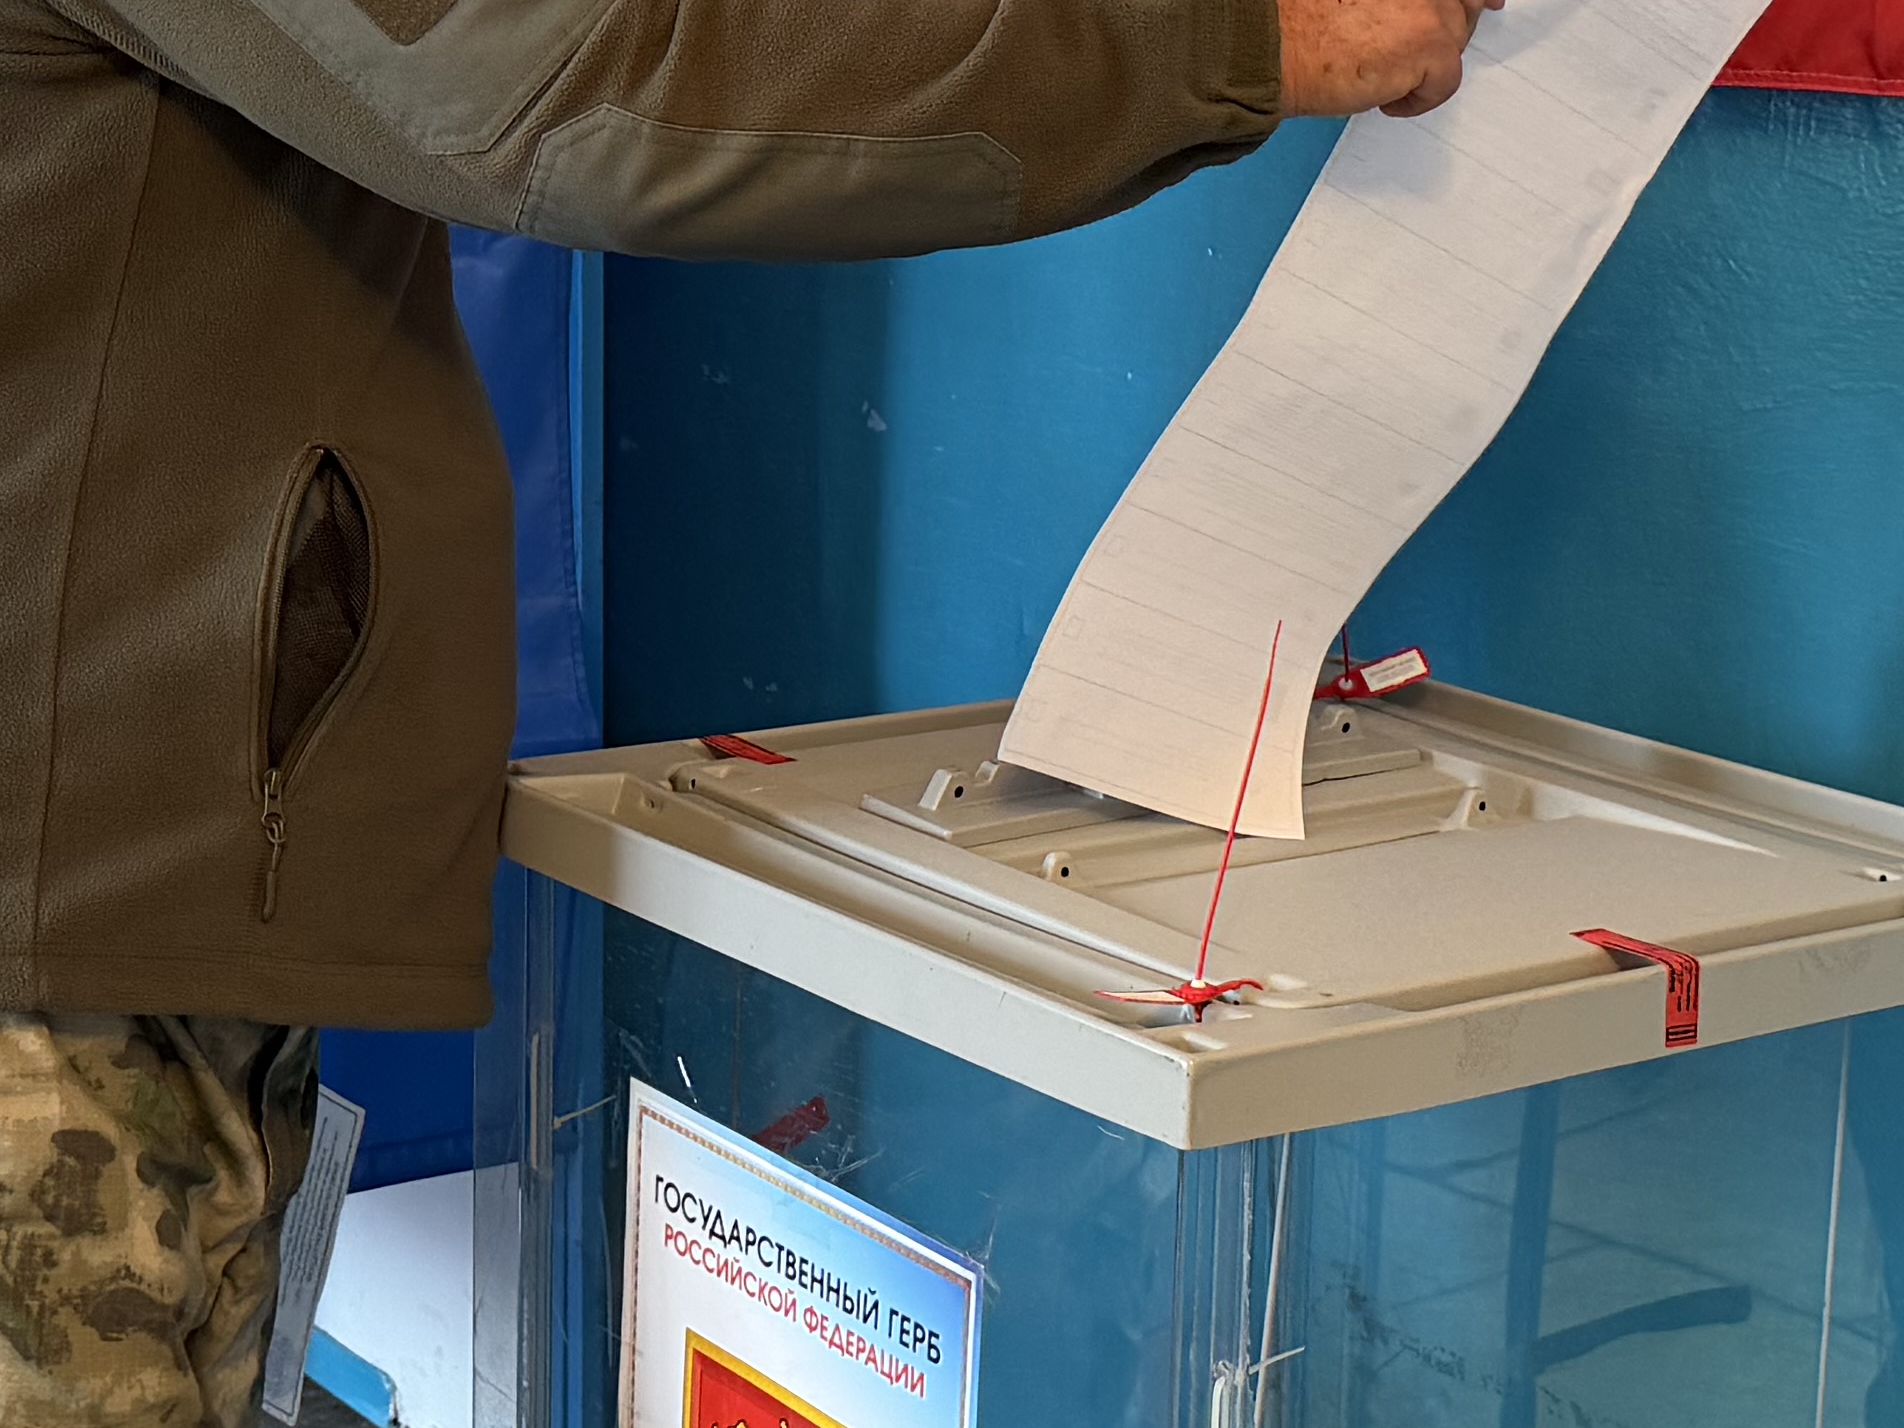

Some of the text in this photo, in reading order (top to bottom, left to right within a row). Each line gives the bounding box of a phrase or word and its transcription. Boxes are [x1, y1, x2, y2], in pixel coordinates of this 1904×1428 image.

[655, 1174, 942, 1365] ГОСУДАРСТВЕННЫЙ ГЕРБ
[664, 1222, 926, 1400] РОССИЙСКОЙ ФЕДЕРАЦИИ
